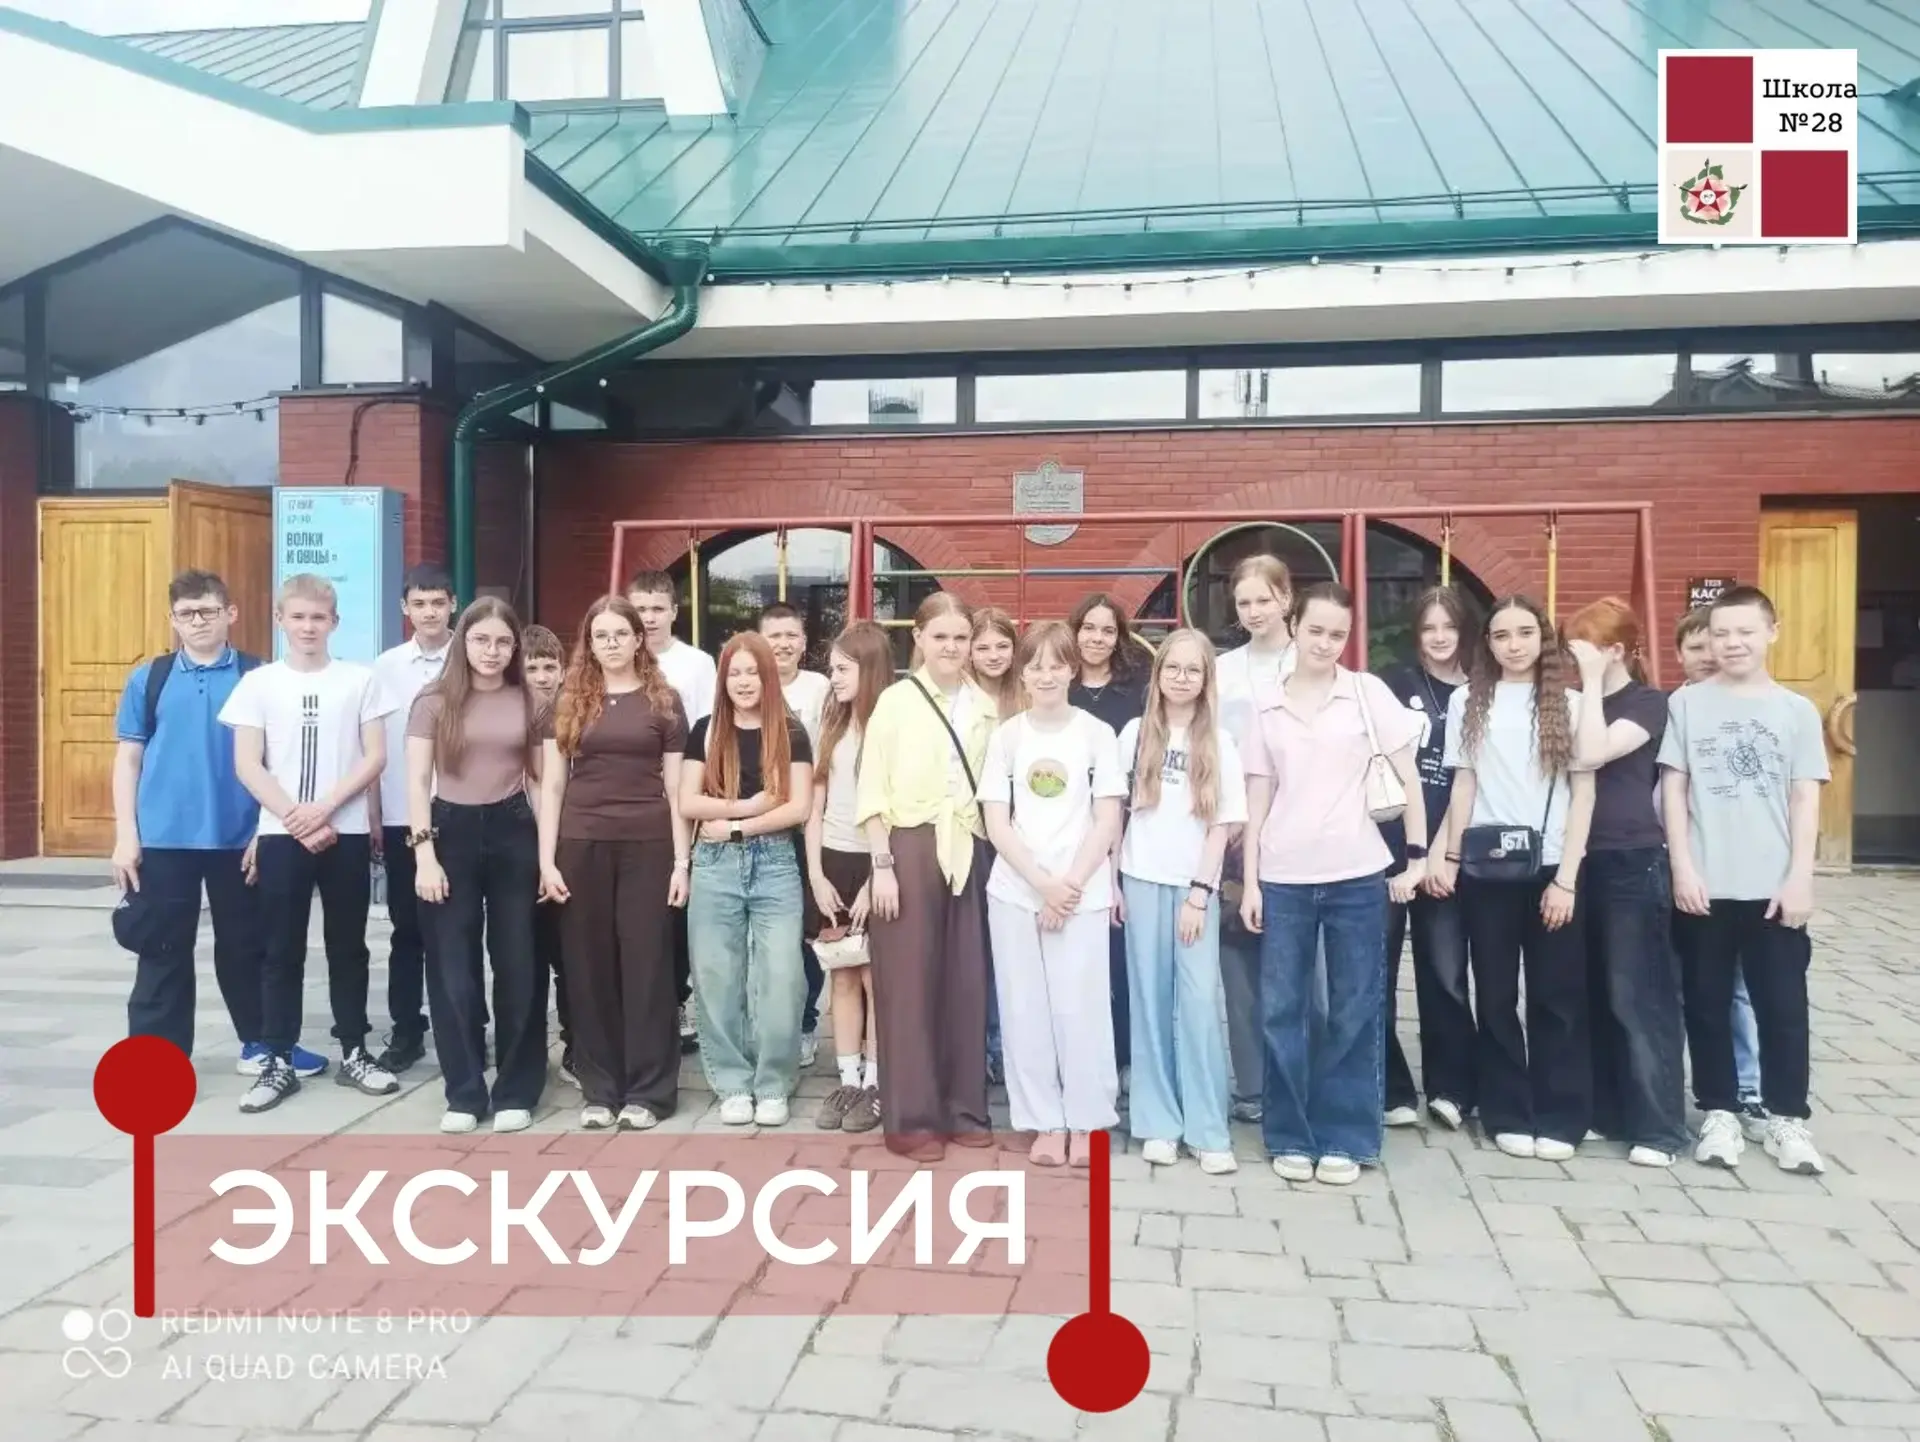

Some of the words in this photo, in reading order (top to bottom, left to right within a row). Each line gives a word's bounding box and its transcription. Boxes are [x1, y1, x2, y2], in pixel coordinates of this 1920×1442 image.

[286, 532, 323, 547] ВОЛКИ
[286, 549, 294, 564] И
[297, 550, 330, 565] ОВЦЫ
[1691, 587, 1726, 599] КАСС
